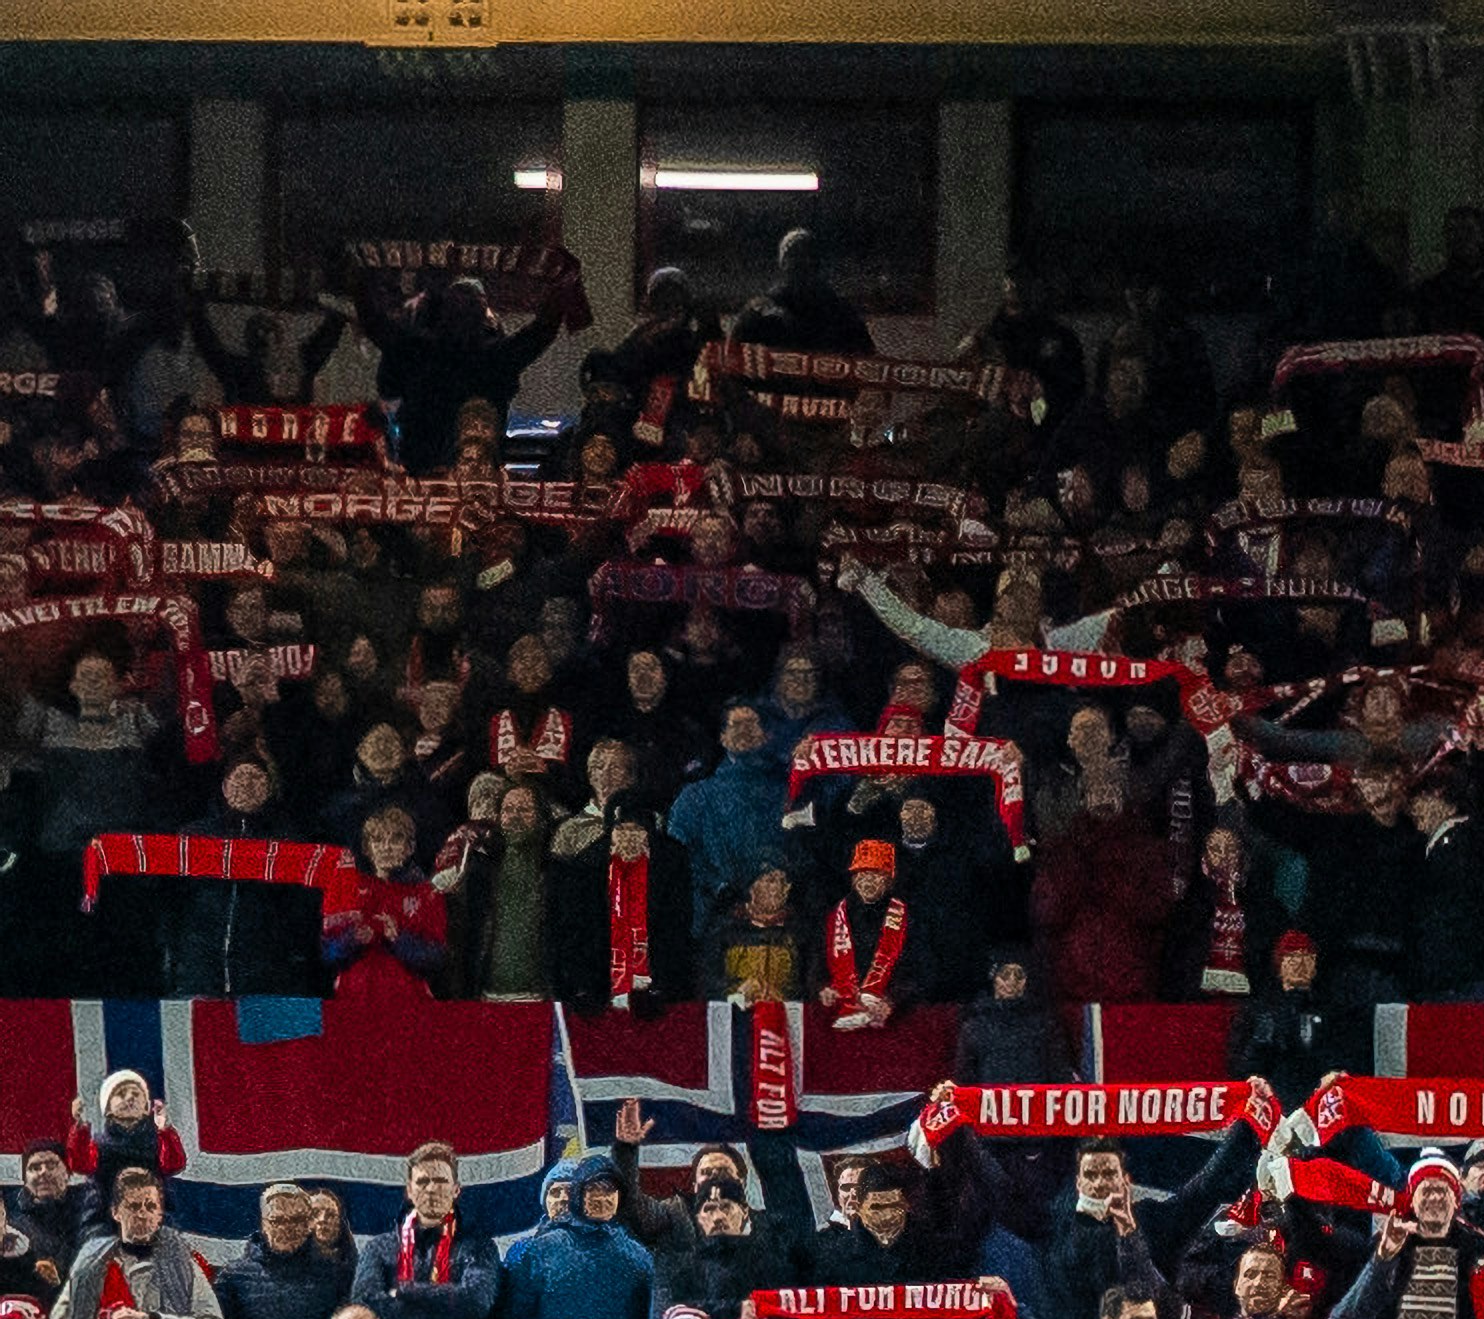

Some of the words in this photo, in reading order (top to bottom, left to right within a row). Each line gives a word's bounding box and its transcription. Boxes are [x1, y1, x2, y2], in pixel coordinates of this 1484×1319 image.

[980, 1086, 1033, 1125] ALT
[1046, 1087, 1106, 1126] FOR
[1118, 1085, 1228, 1125] NORGE
